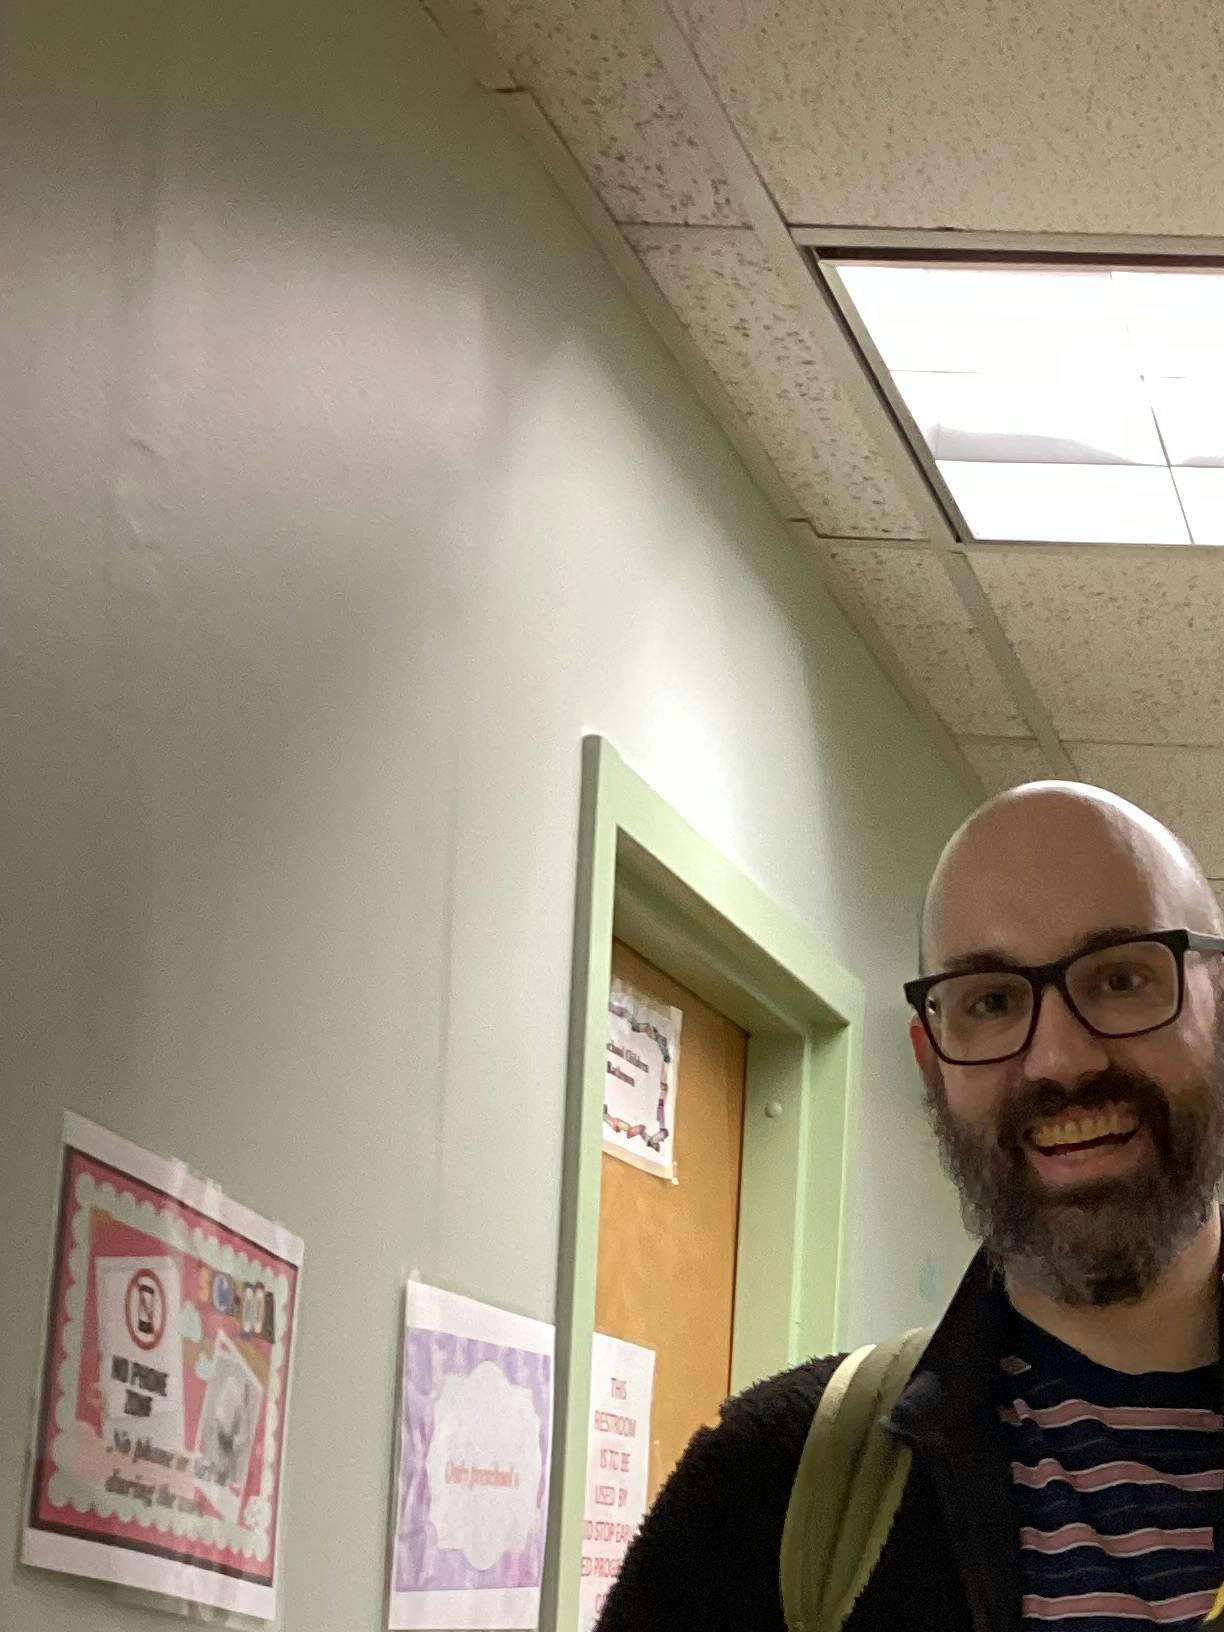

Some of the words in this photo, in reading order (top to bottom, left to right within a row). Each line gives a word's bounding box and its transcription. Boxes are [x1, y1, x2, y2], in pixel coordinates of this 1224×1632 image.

[610, 1377, 627, 1401] THIS
[594, 1409, 637, 1438] RESTROOM
[620, 1452, 631, 1473] BE
[595, 1485, 615, 1506] USED
